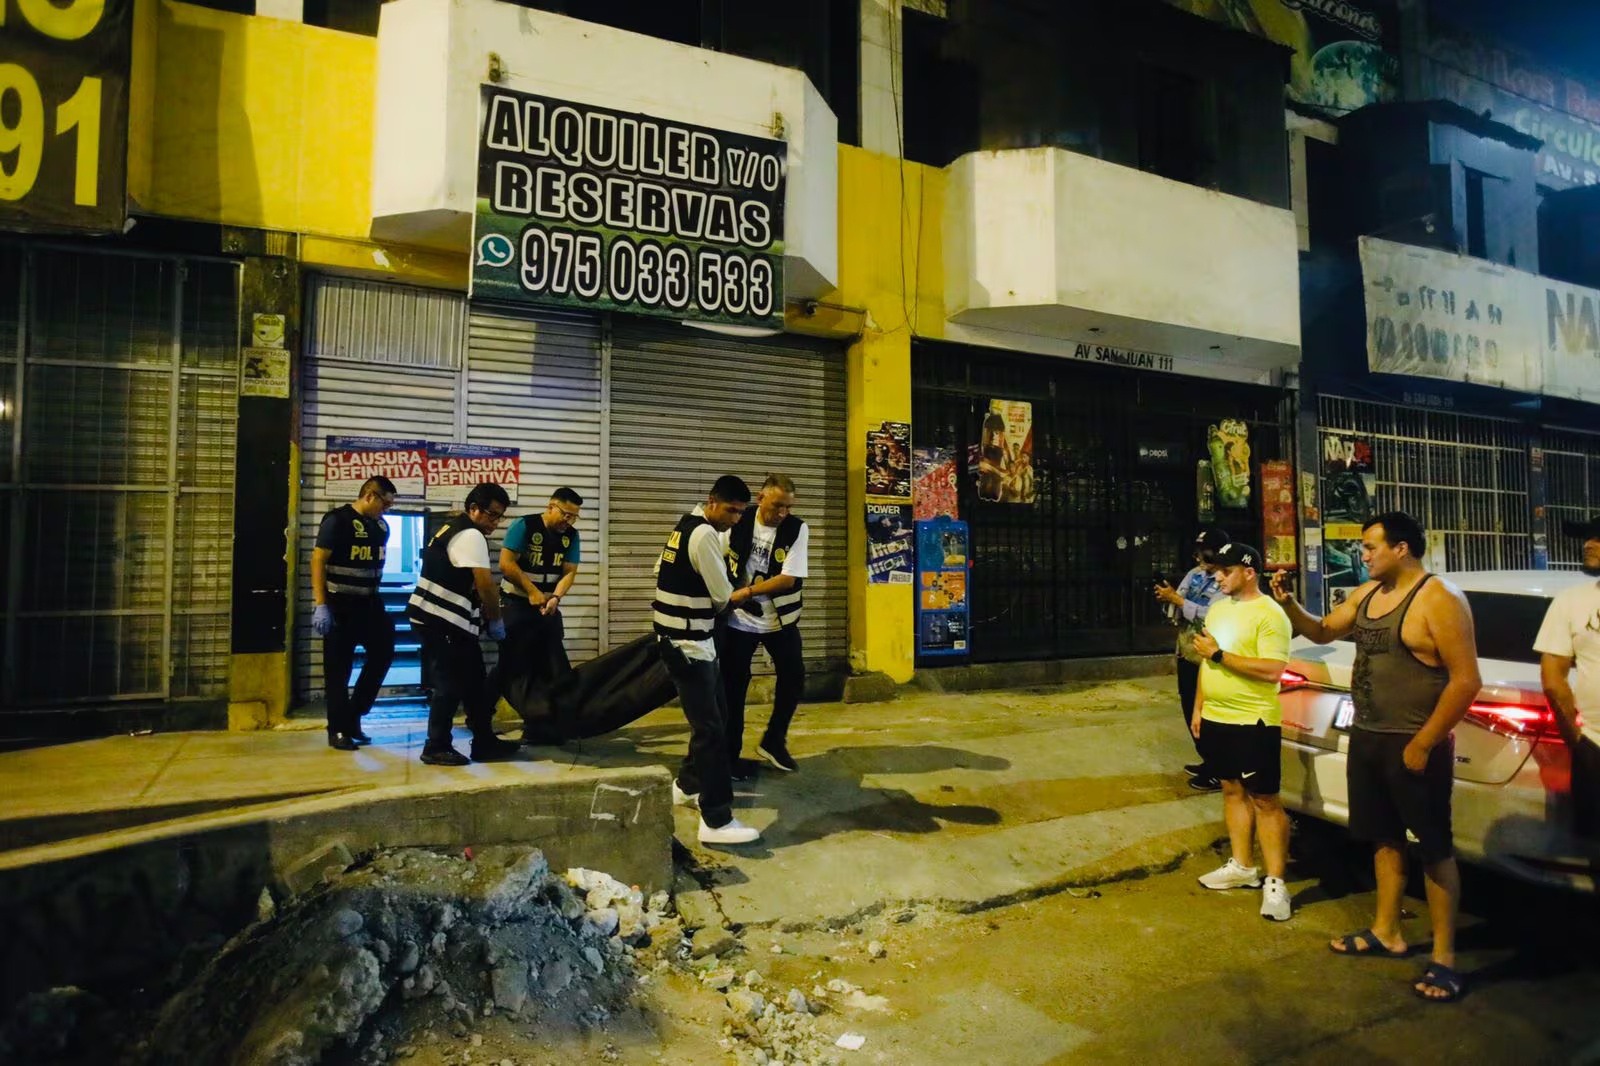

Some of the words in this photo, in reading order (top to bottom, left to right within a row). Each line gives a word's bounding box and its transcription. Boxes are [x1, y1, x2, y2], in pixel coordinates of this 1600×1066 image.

[0, 63, 102, 207] 91
[487, 95, 720, 185] ALQUILER
[727, 147, 779, 191] Y/O
[495, 160, 771, 247] RESERVAS
[521, 228, 601, 297] 975
[609, 240, 690, 307] 033
[697, 252, 773, 316] 533
[1074, 343, 1091, 359] AV
[1095, 346, 1119, 362] SAN
[1158, 356, 1174, 371] 111
[327, 451, 422, 467] CLAUSURA
[427, 458, 516, 473] CLAUSURA
[327, 464, 424, 480] DEFINITIVA
[428, 471, 518, 486] DEFINITIVA
[867, 504, 900, 515] POWER
